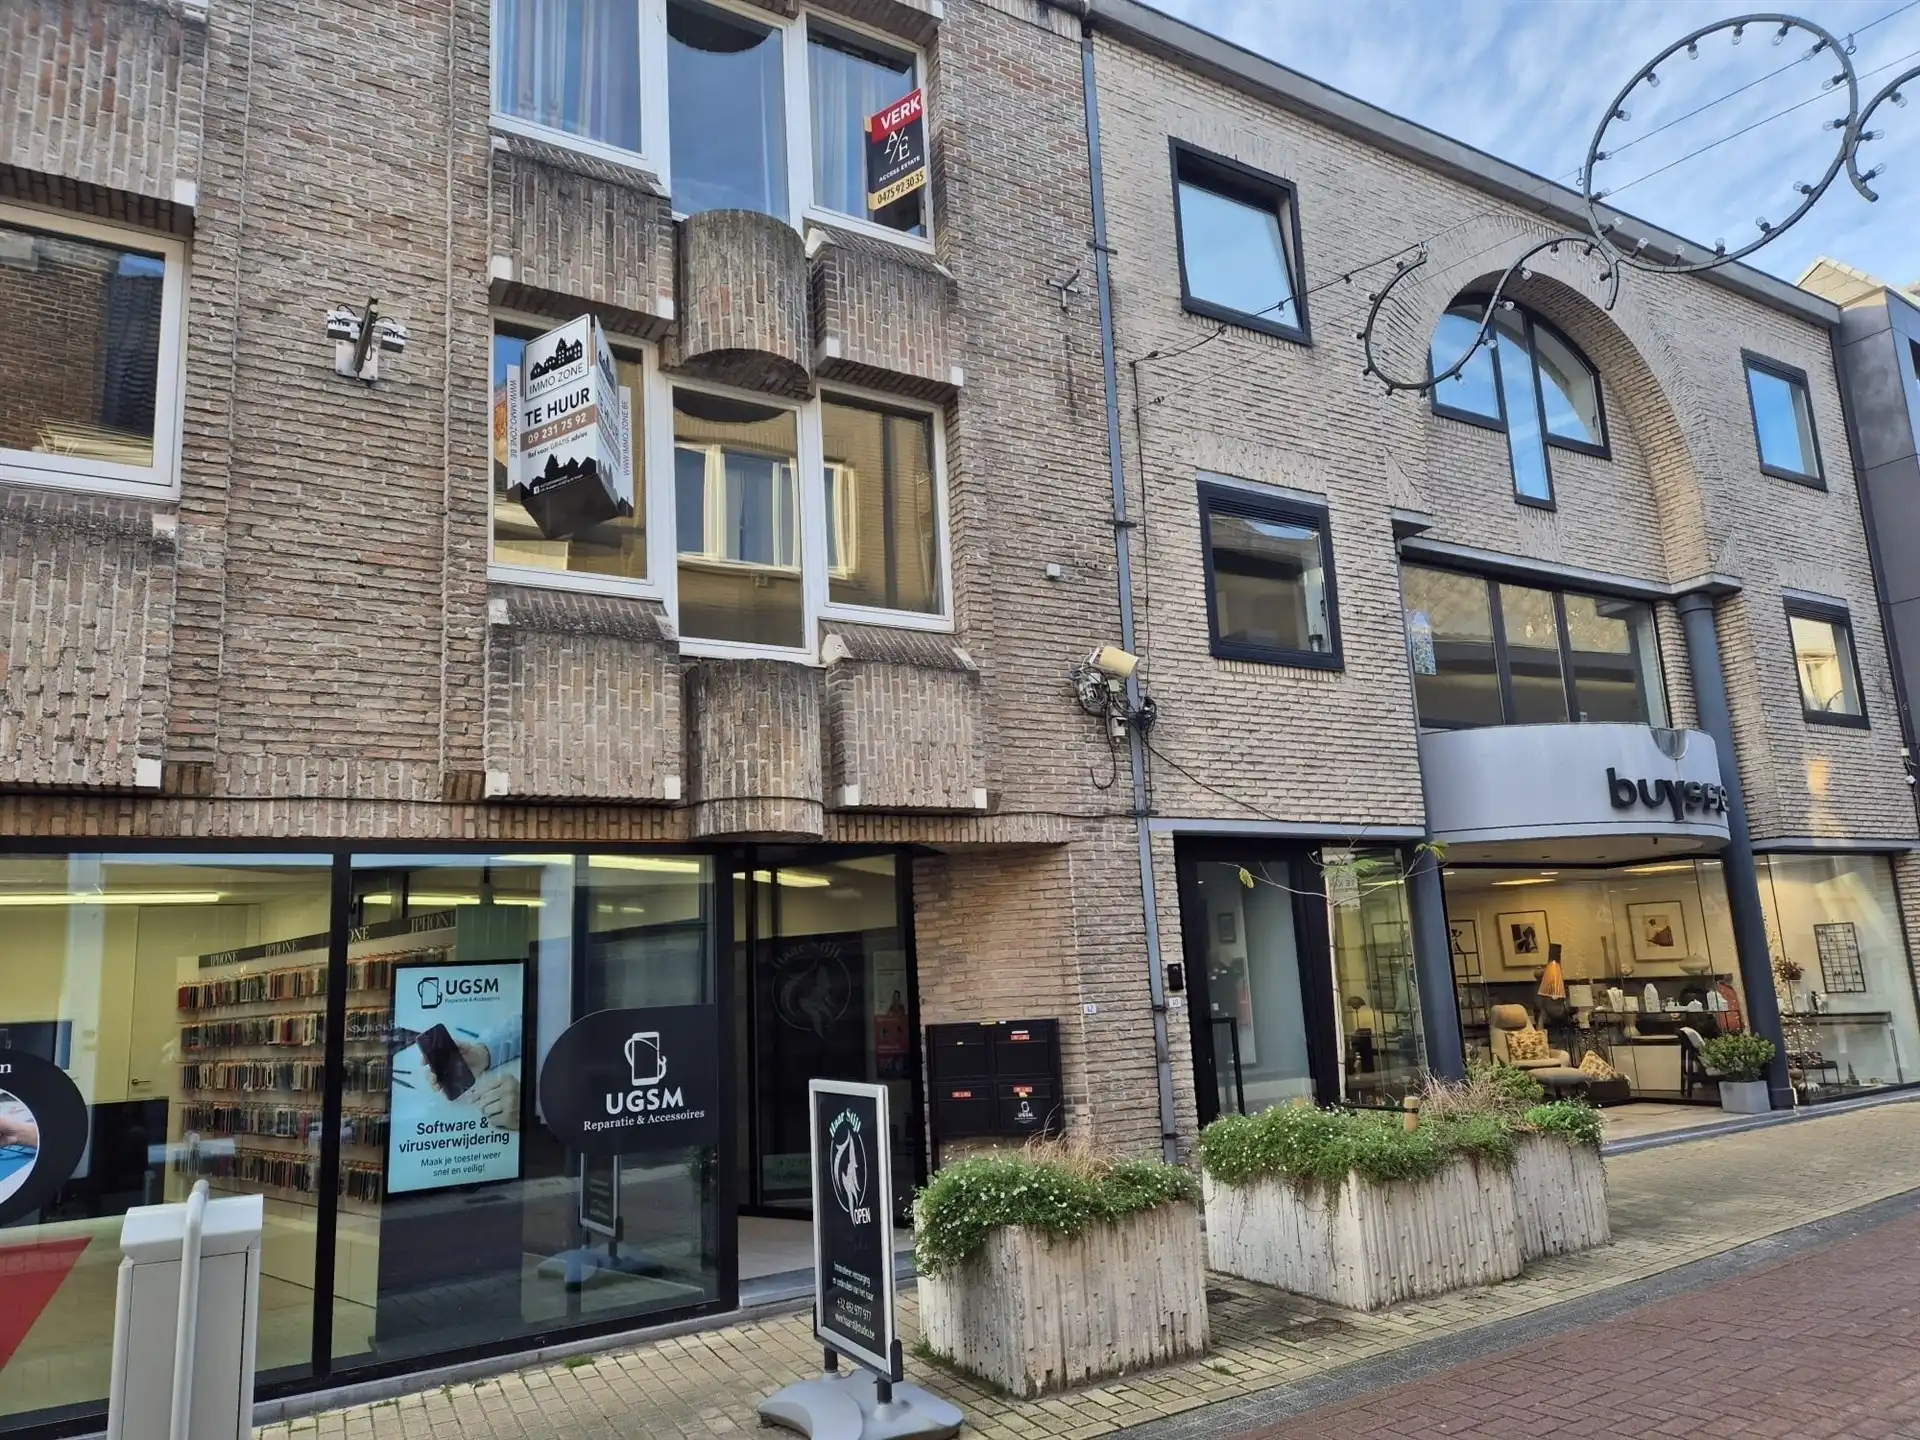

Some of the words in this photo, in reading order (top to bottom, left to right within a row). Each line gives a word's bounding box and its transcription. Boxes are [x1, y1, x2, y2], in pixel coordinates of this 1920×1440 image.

[881, 95, 921, 130] VERK
[879, 167, 900, 183] ACCESS
[901, 155, 921, 171] ESTATE
[877, 189, 895, 204] 0475
[895, 184, 905, 197] 92
[905, 178, 915, 191] 30
[915, 171, 924, 183] 35
[529, 375, 555, 395] IMMO
[557, 362, 583, 382] ZONE
[524, 407, 542, 427] TE
[547, 387, 590, 419] HUUR
[528, 432, 539, 444] 09
[542, 424, 558, 439] 231
[561, 418, 572, 431] 75
[575, 412, 586, 425] 92
[446, 978, 499, 995] UGSM
[606, 1086, 684, 1115] UGSM
[416, 1120, 476, 1135] Software
[480, 1116, 489, 1129] &
[583, 1116, 634, 1132] Reparatie
[637, 1115, 645, 1125] &
[647, 1109, 705, 1124] Accessoires
[399, 1131, 510, 1153] virusverwijdering
[420, 1157, 443, 1167] Maak
[444, 1157, 452, 1166] je
[454, 1153, 481, 1164] toestel
[482, 1151, 502, 1160] weer
[433, 1167, 450, 1177] snel
[451, 1167, 461, 1175] en
[463, 1163, 486, 1174] veilig!
[854, 1207, 871, 1225] OPEN
